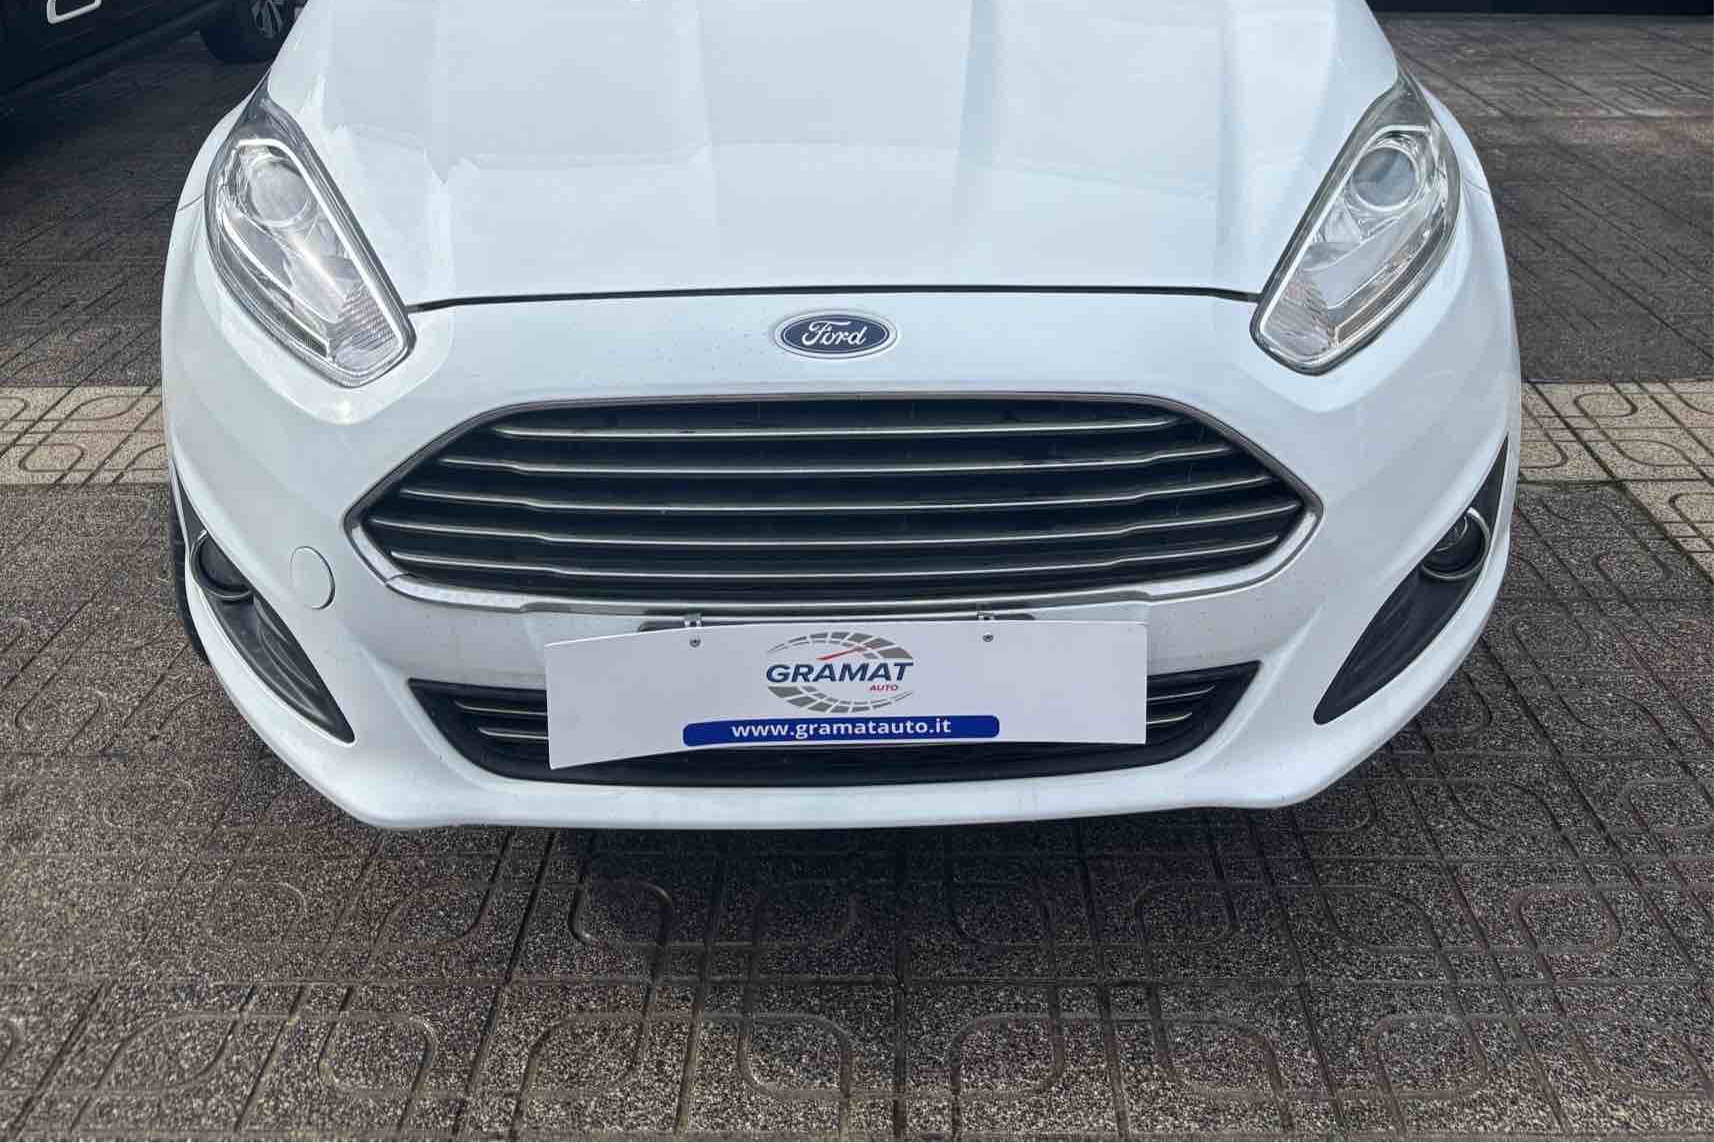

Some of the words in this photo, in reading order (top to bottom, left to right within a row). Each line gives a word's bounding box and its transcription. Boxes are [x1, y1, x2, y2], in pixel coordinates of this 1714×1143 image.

[801, 321, 869, 347] Ford
[765, 661, 915, 684] GRAMAT
[869, 683, 900, 692] AUTO
[731, 717, 952, 740] www.gramatauto.it
